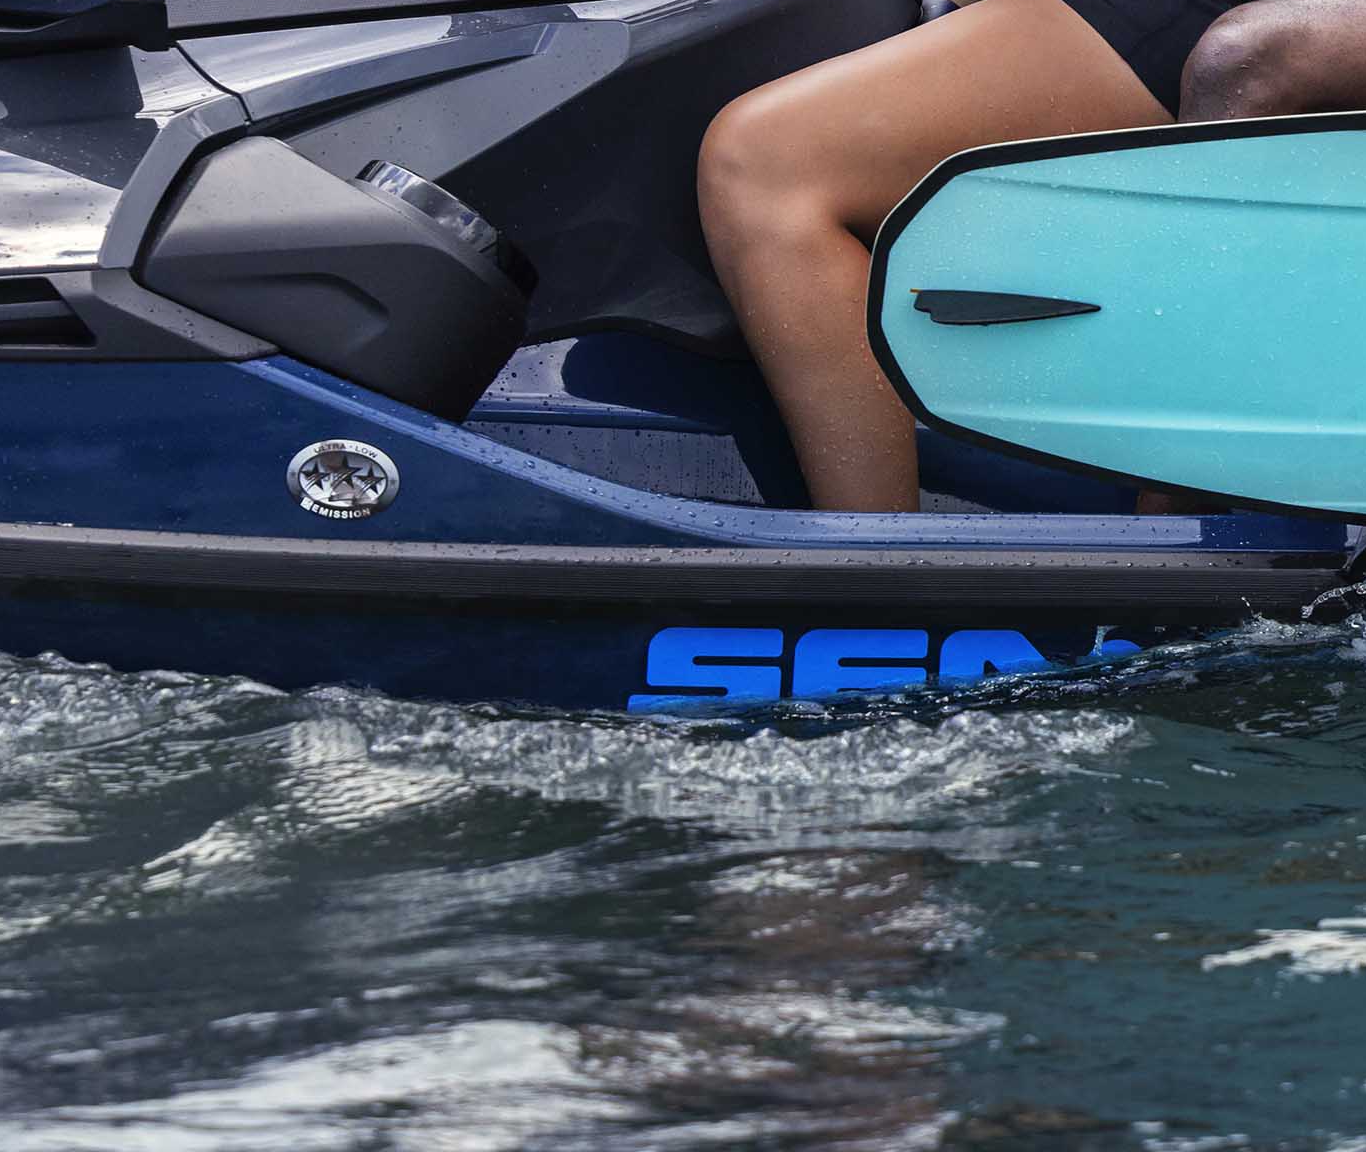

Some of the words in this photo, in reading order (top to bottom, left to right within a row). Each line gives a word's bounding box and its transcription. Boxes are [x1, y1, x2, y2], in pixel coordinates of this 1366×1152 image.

[314, 442, 347, 454] ULTRA
[354, 446, 378, 460] LOW
[311, 503, 371, 519] EMISSION
